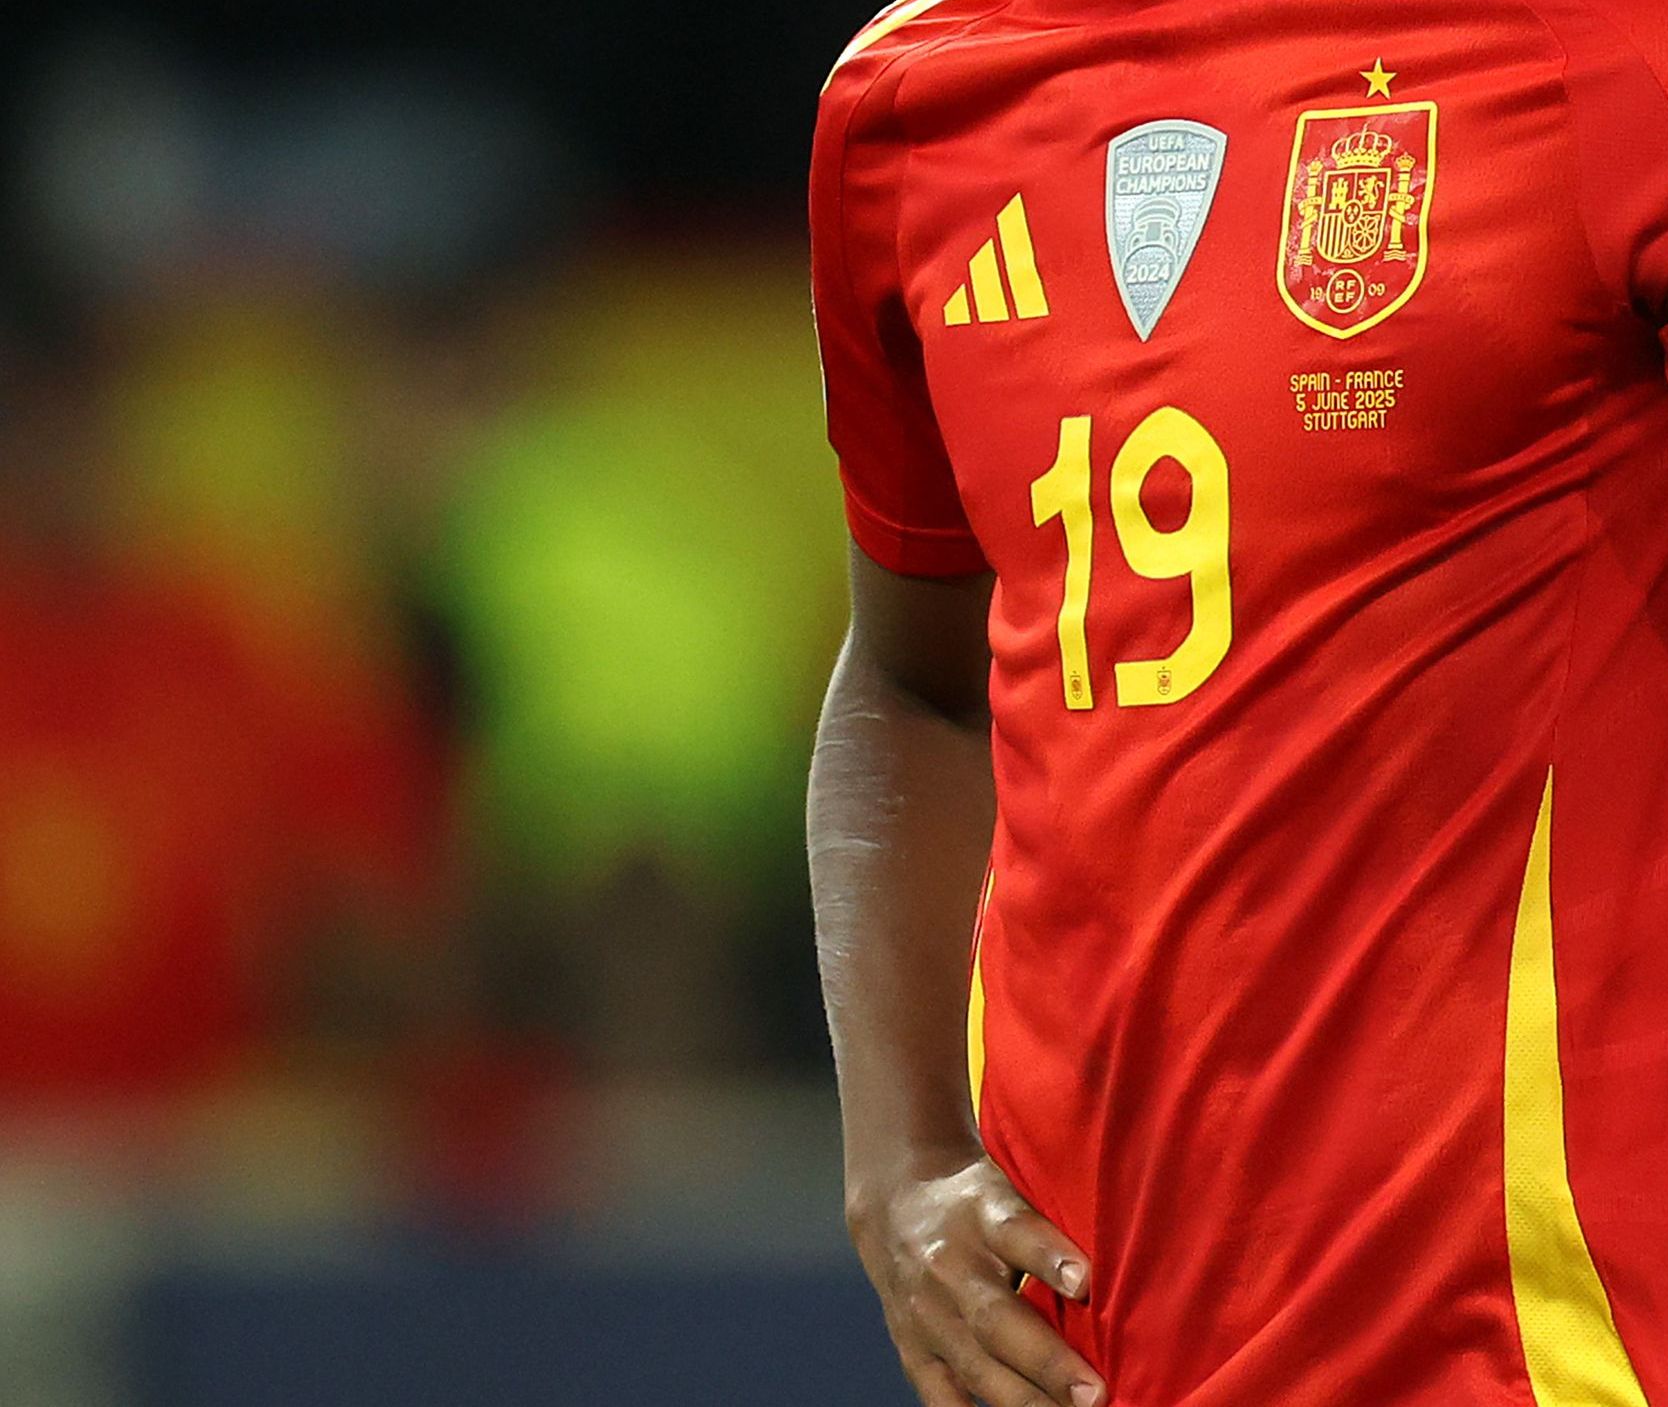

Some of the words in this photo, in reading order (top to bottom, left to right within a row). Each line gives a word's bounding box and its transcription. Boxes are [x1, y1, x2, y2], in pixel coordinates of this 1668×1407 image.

[1149, 136, 1185, 151] UEFA
[1118, 153, 1210, 175] EUROPEAN
[1116, 176, 1207, 196] CHAMPIONS
[1126, 263, 1170, 284] 2024
[1290, 372, 1331, 392] SPAIN
[1346, 369, 1405, 390] FRANCE
[1296, 393, 1306, 412] 5
[1312, 391, 1350, 410] JUNE
[1355, 389, 1396, 410] 2025
[1304, 409, 1388, 432] STUTTGART
[1030, 405, 1233, 710] 19
